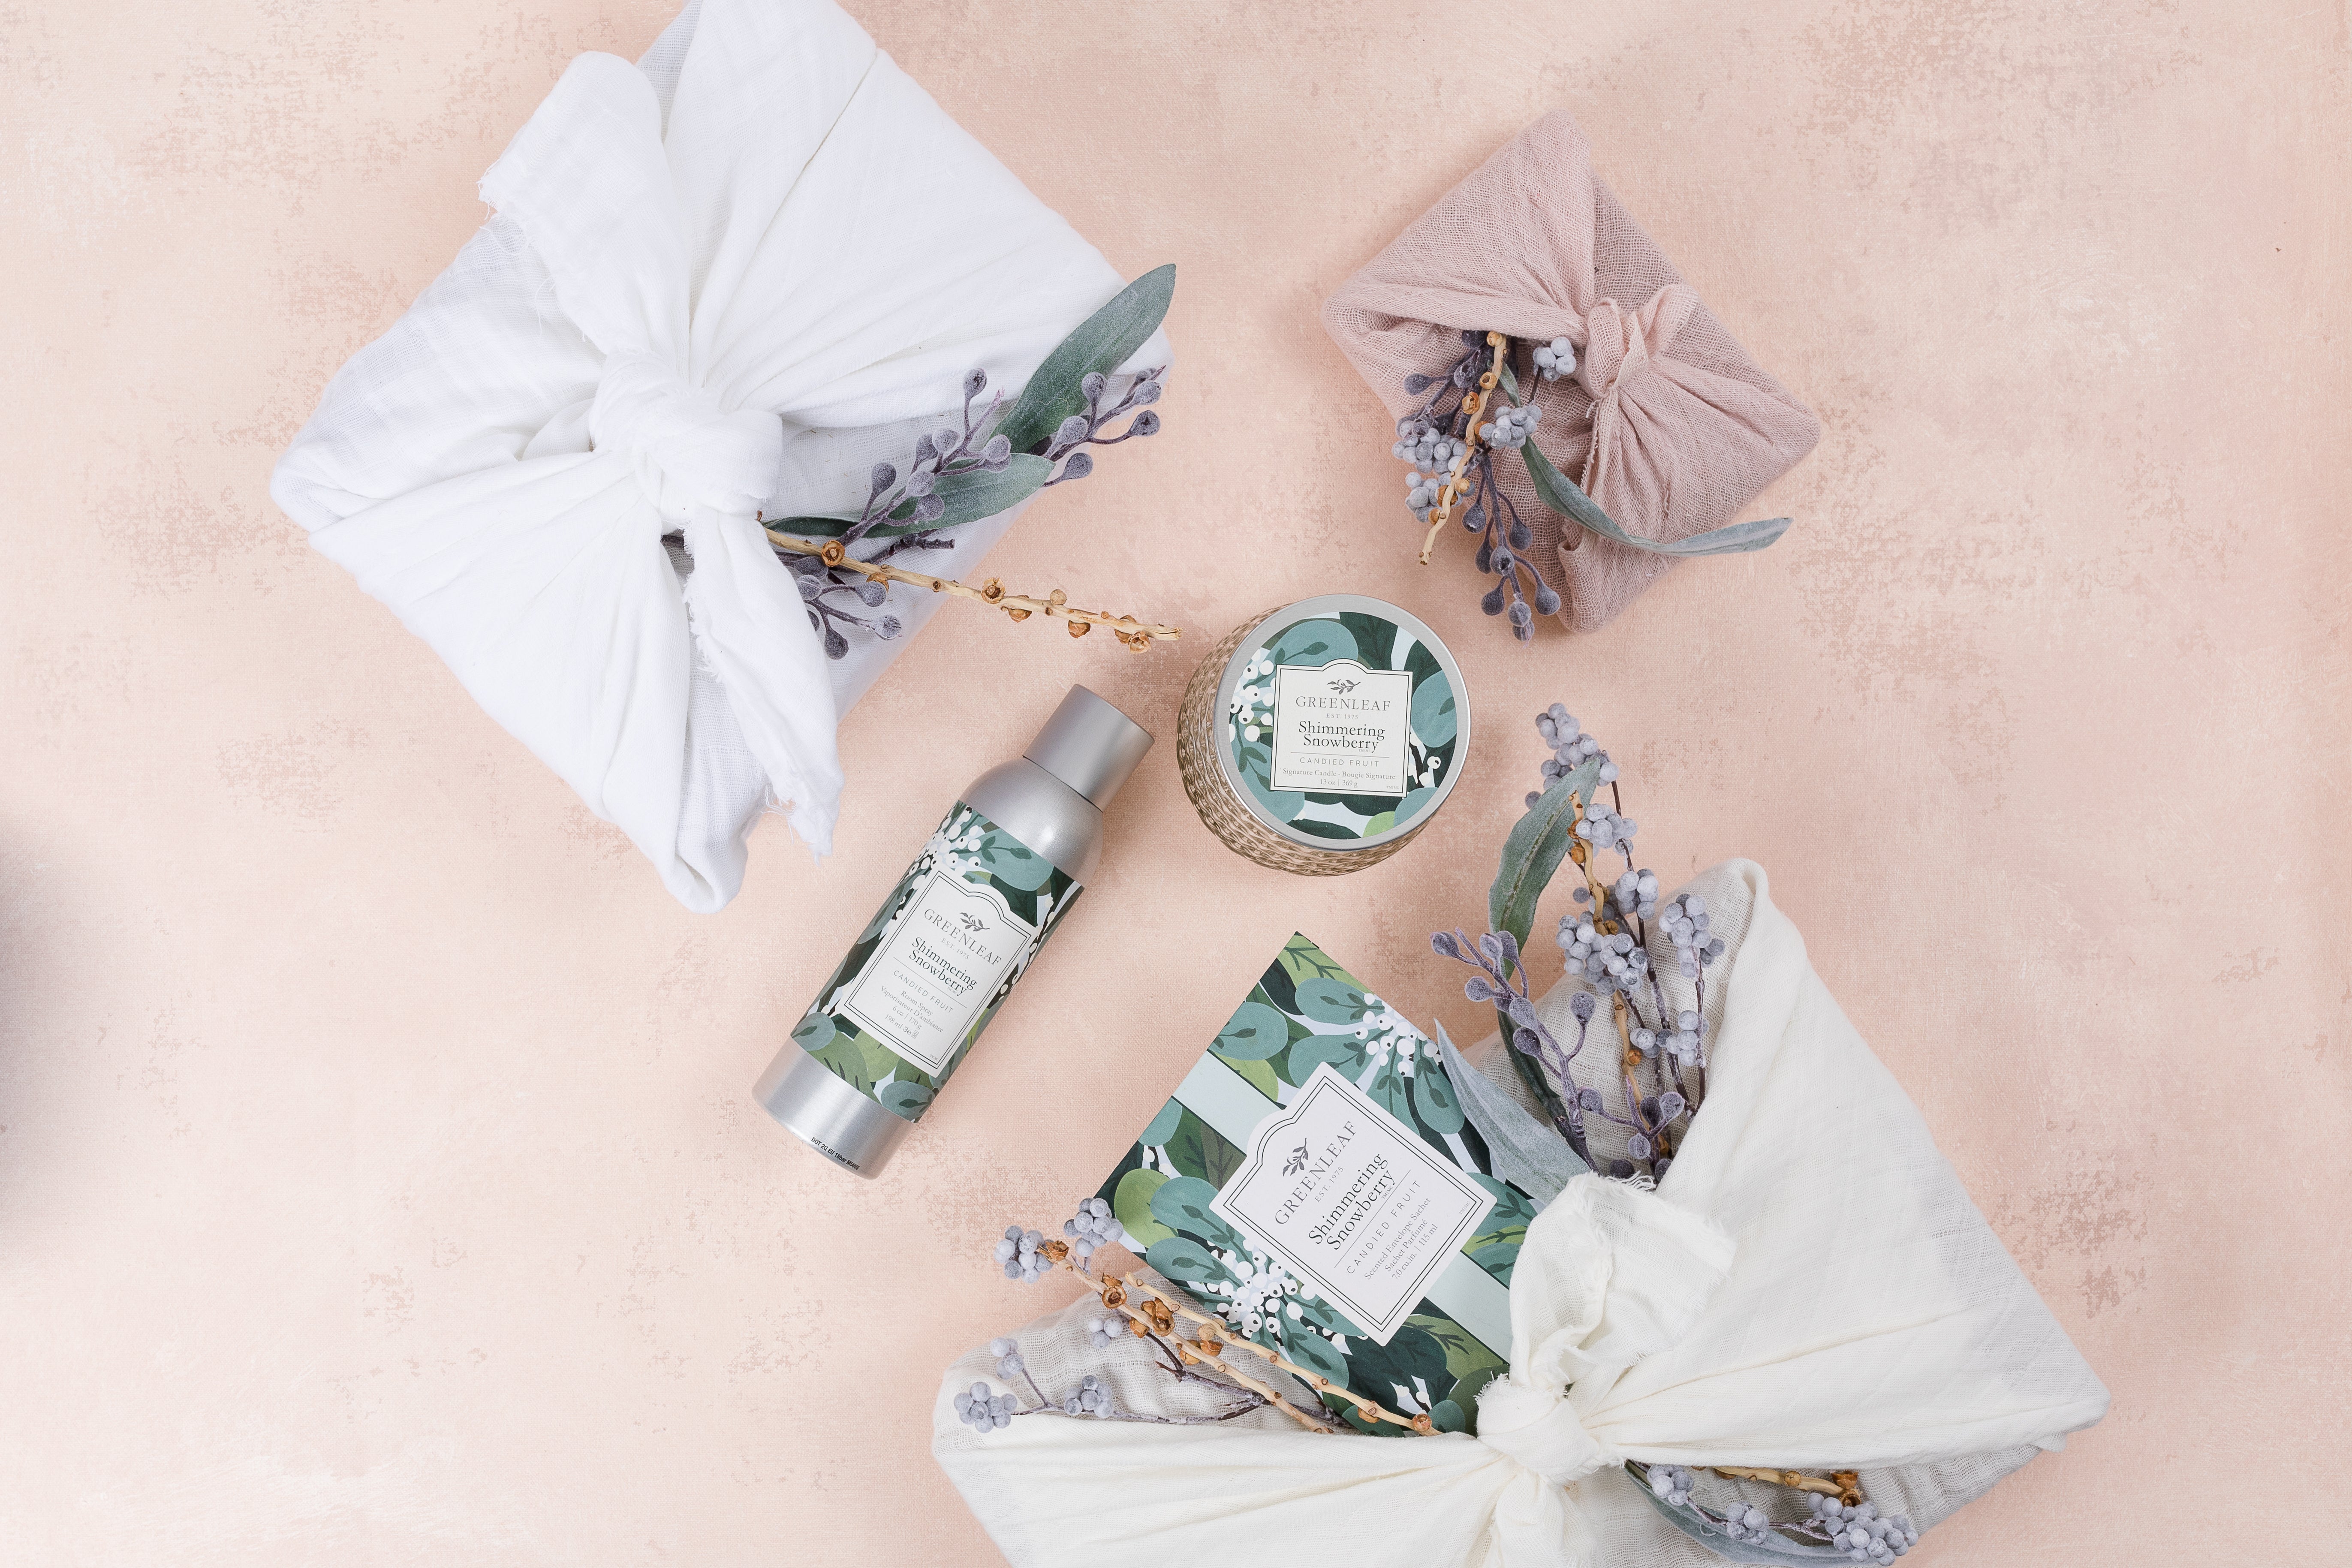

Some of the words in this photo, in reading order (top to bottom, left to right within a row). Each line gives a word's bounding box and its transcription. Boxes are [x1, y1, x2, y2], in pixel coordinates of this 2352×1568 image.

[1295, 696, 1391, 711] GREENLEAF
[1299, 721, 1385, 741] Shimmering
[1303, 734, 1378, 753] Snowberry
[1283, 768, 1313, 776] Signature
[1342, 771, 1364, 779] Bougie
[1365, 772, 1396, 780] Signature
[1300, 757, 1344, 766] CANDIED
[924, 909, 1002, 966] GREENLEAF
[941, 938, 956, 950] EST.
[957, 948, 970, 959] 1975
[909, 949, 967, 996] Snowberry
[912, 937, 977, 990] Shimmering
[881, 985, 914, 1012] Vaporisateur
[894, 970, 928, 996] CANDIED
[930, 996, 953, 1013] FRUIT
[900, 990, 918, 1005] Room
[918, 1002, 933, 1017] Spray
[885, 1014, 895, 1023] 198
[909, 1017, 919, 1026] 170
[811, 1137, 822, 1146] DOT
[820, 1144, 828, 1152] 2Q
[834, 1153, 847, 1163] 18bar
[846, 1159, 860, 1170] M5655
[1275, 1121, 1356, 1225] GREENLEAF
[1314, 1185, 1331, 1202] EST.
[1329, 1166, 1343, 1183] 1975
[1308, 1154, 1388, 1245] Shimmering
[1327, 1170, 1395, 1250] Snowberry
[1347, 1222, 1389, 1274] CANDIED
[1391, 1180, 1420, 1217] FRUIT
[1364, 1252, 1388, 1280] Scented
[1385, 1221, 1413, 1253] Envelope
[1410, 1198, 1431, 1221] Sachet
[1385, 1249, 1405, 1272] Sachet
[1402, 1219, 1427, 1249] Parfumé
[1391, 1269, 1402, 1279] 7.0
[1402, 1254, 1417, 1270] cu.in.
[1418, 1233, 1430, 1246] 115
[1429, 1223, 1438, 1235] ml
